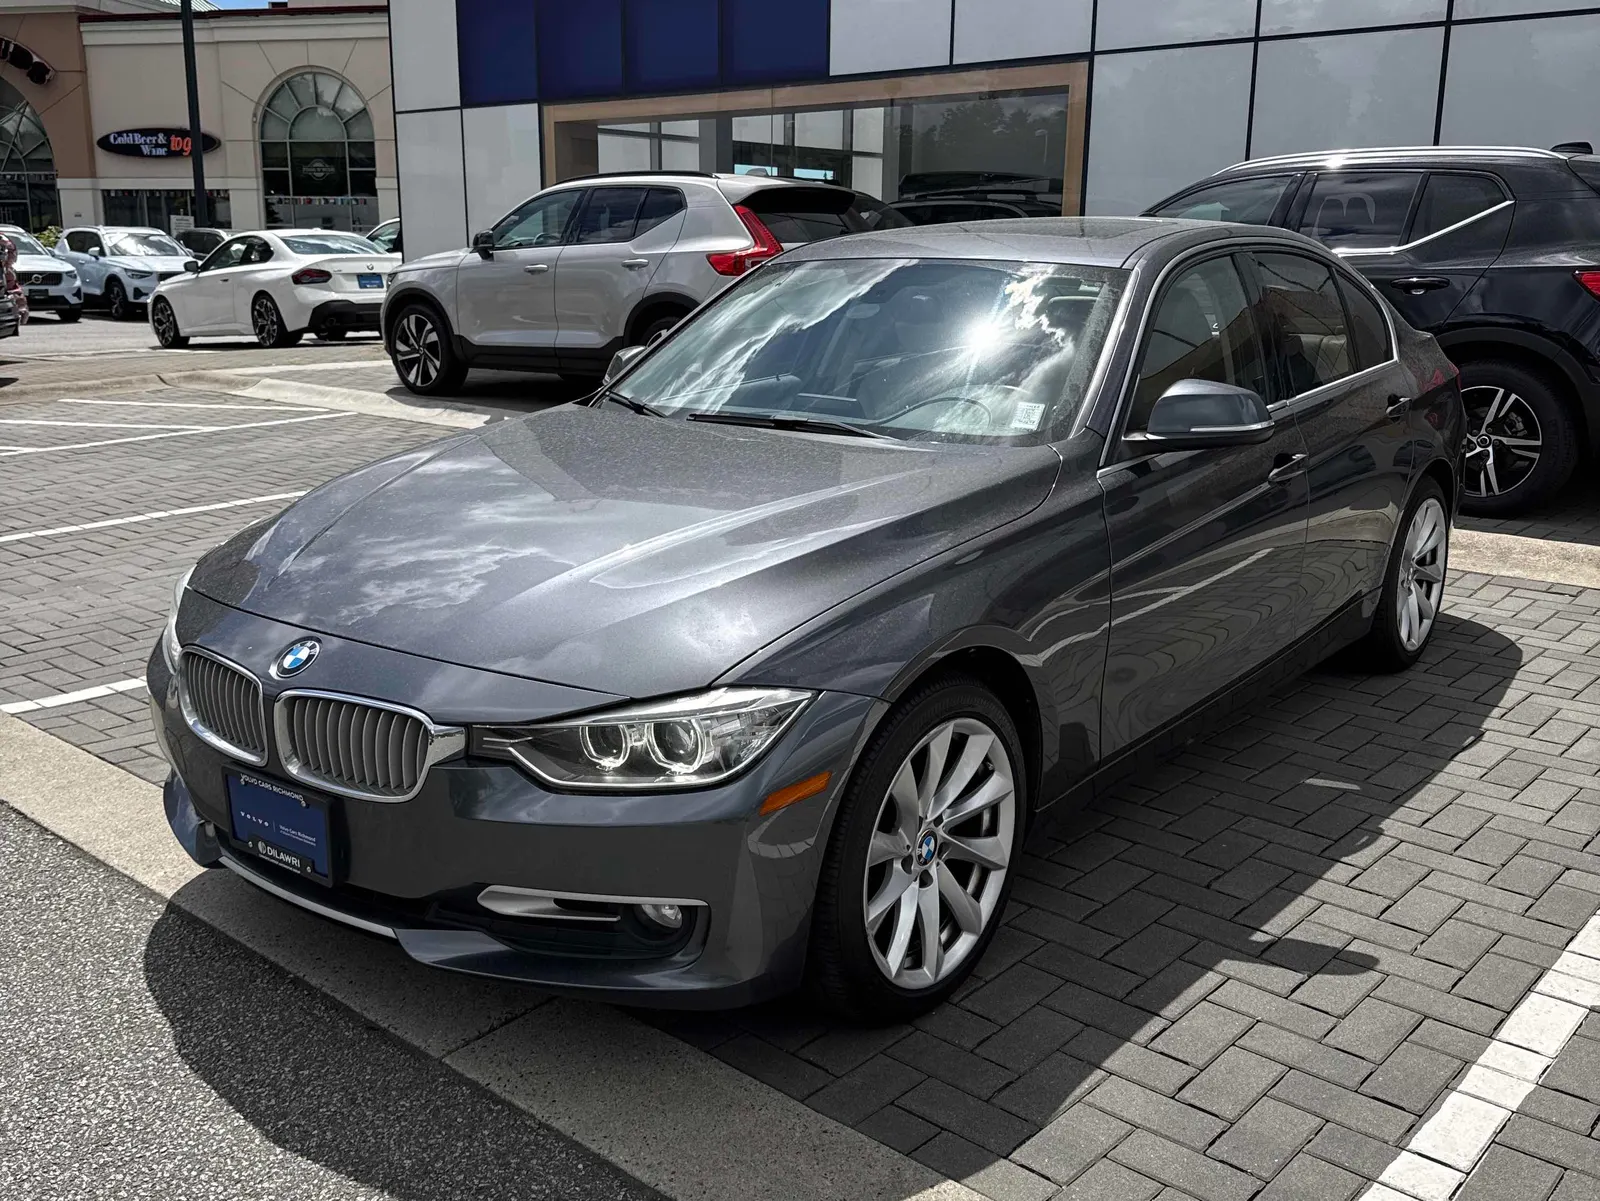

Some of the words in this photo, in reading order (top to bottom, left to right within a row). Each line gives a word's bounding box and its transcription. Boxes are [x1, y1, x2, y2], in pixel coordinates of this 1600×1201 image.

[110, 133, 132, 144] Cold
[134, 133, 157, 144] Beer
[140, 145, 168, 155] Wine
[258, 780, 272, 791] CARS
[272, 785, 304, 802] RICHMOND
[240, 811, 269, 827] VOLVO
[267, 846, 301, 868] DILAWRI
